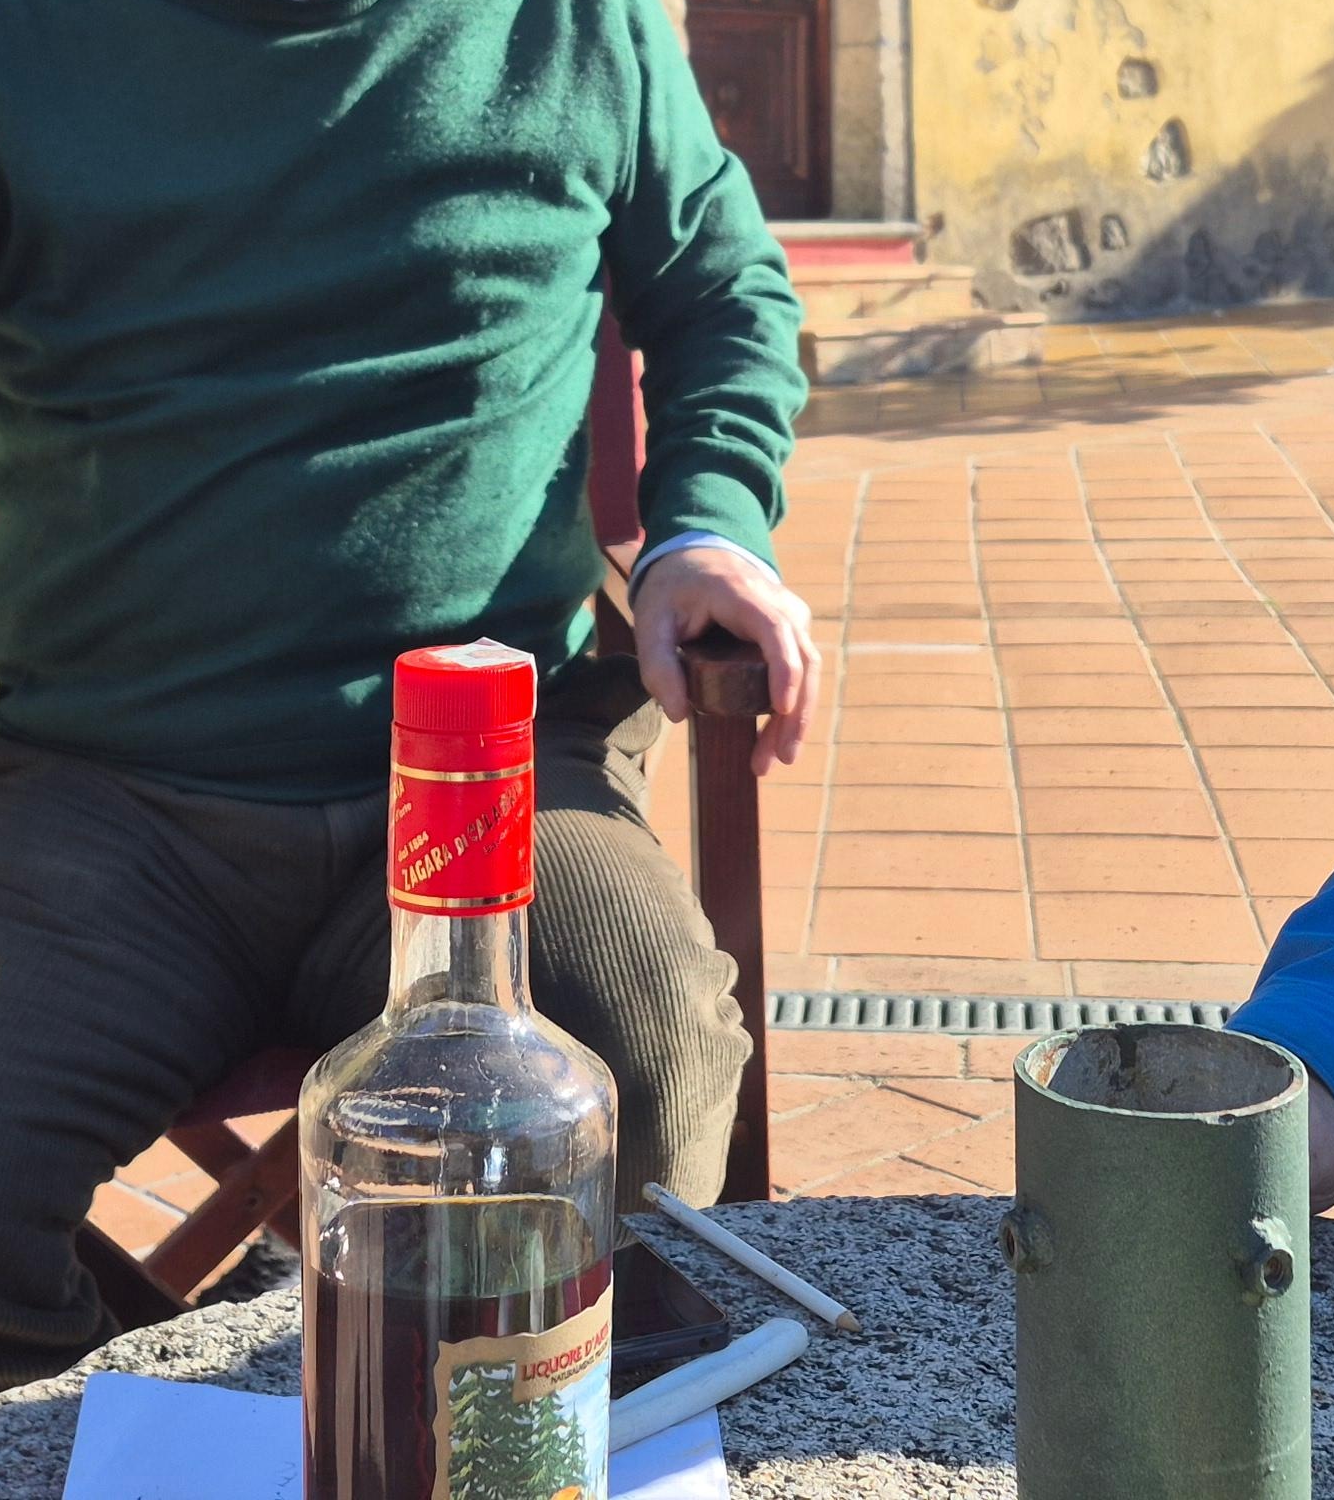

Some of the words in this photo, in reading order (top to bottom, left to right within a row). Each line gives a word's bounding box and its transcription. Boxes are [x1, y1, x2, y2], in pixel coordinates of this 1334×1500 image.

[402, 842, 454, 892] ZAGARA
[453, 833, 469, 857] DI
[521, 1345, 583, 1382] LIQUORE
